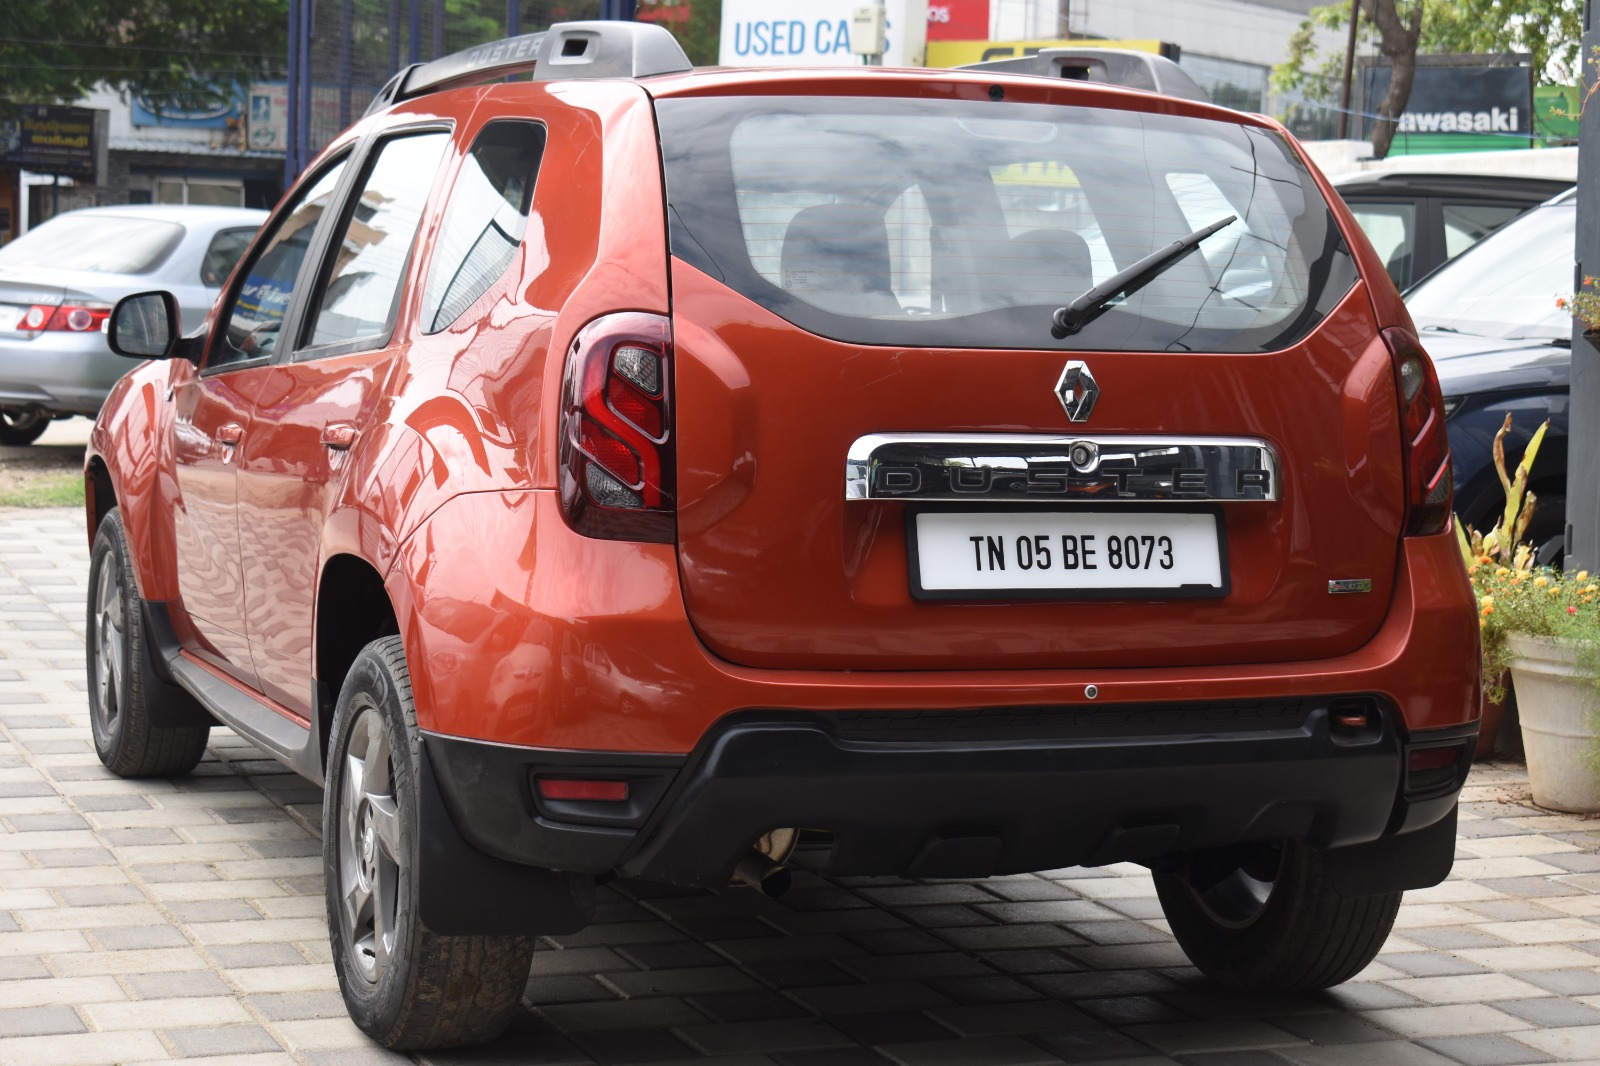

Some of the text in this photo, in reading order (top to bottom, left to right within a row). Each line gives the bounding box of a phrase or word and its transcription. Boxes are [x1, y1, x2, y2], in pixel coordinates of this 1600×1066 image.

[467, 37, 545, 68] DUSTER
[735, 20, 891, 56] USED CA
[1396, 106, 1518, 132] awasaki
[876, 466, 1271, 494] DUSTER
[969, 535, 1175, 572] TN 05 BE 8073
